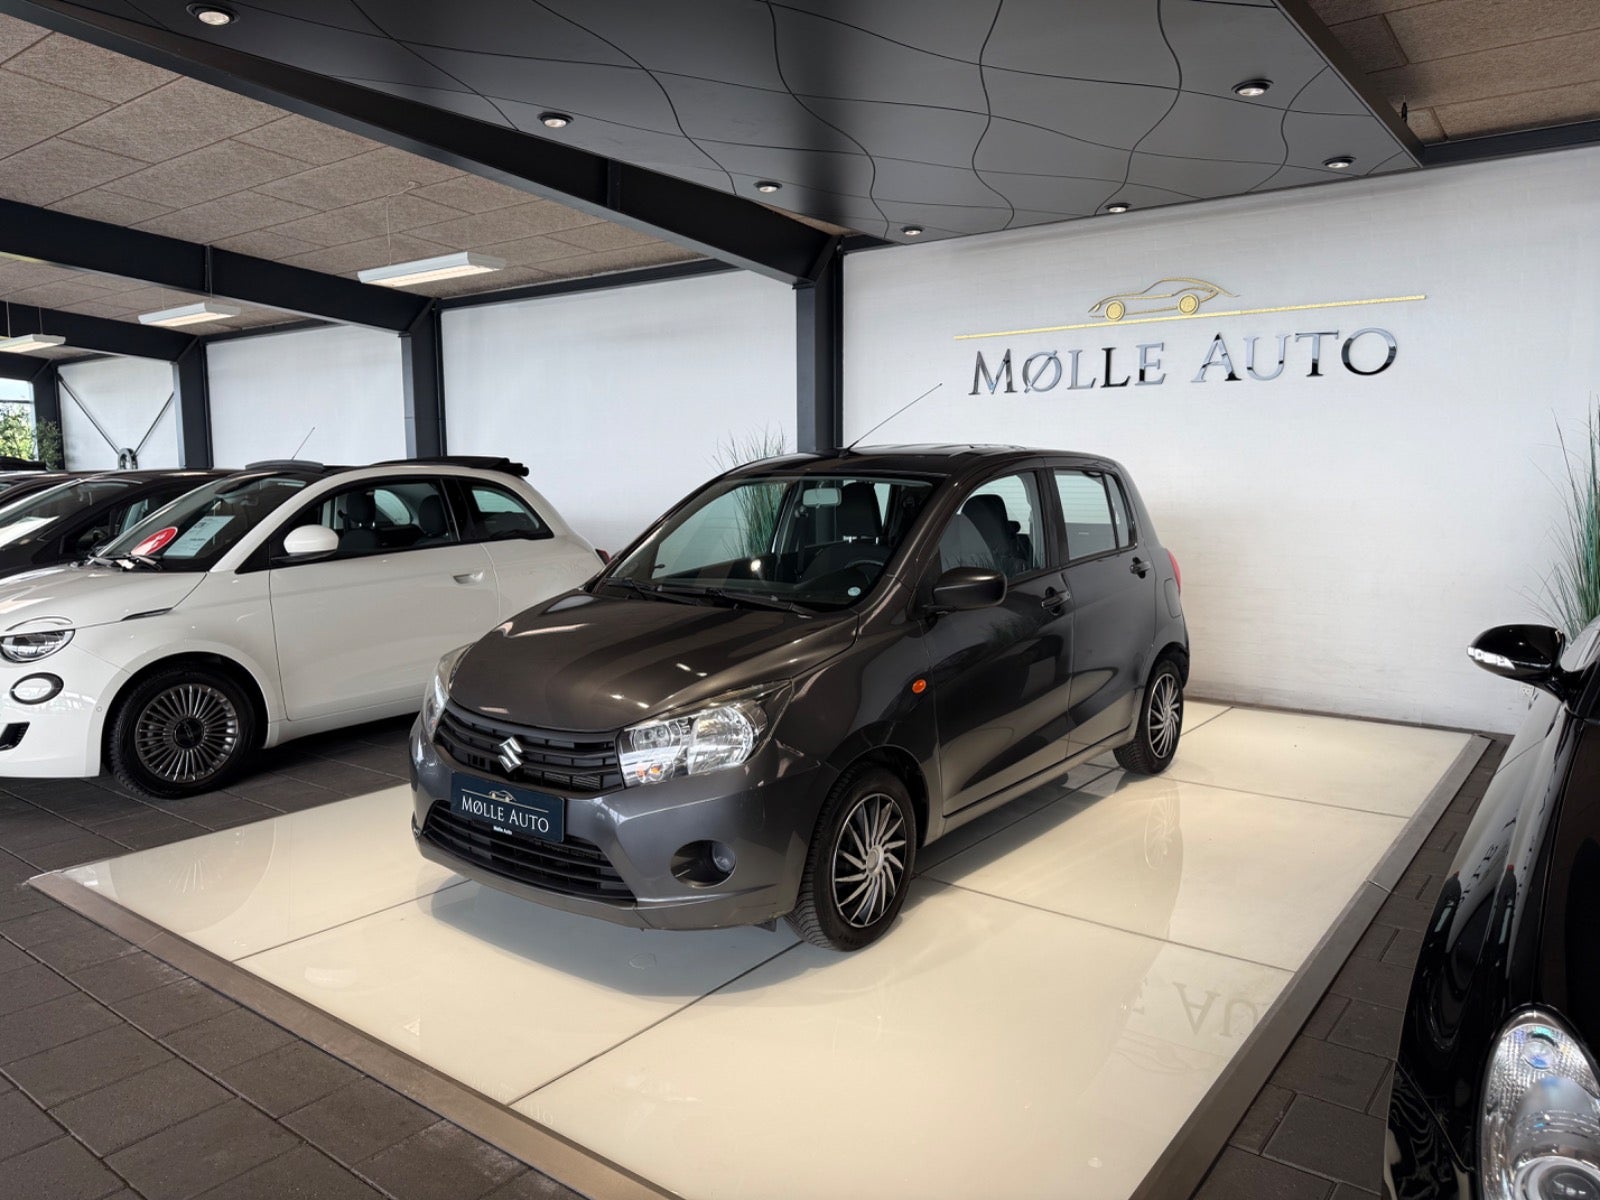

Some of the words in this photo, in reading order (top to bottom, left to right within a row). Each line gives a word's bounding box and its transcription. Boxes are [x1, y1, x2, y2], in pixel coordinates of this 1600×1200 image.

[968, 342, 1167, 396] MØLLE
[1190, 327, 1398, 383] AUTO
[461, 795, 504, 821] MØLLE
[509, 809, 549, 832] AUTO
